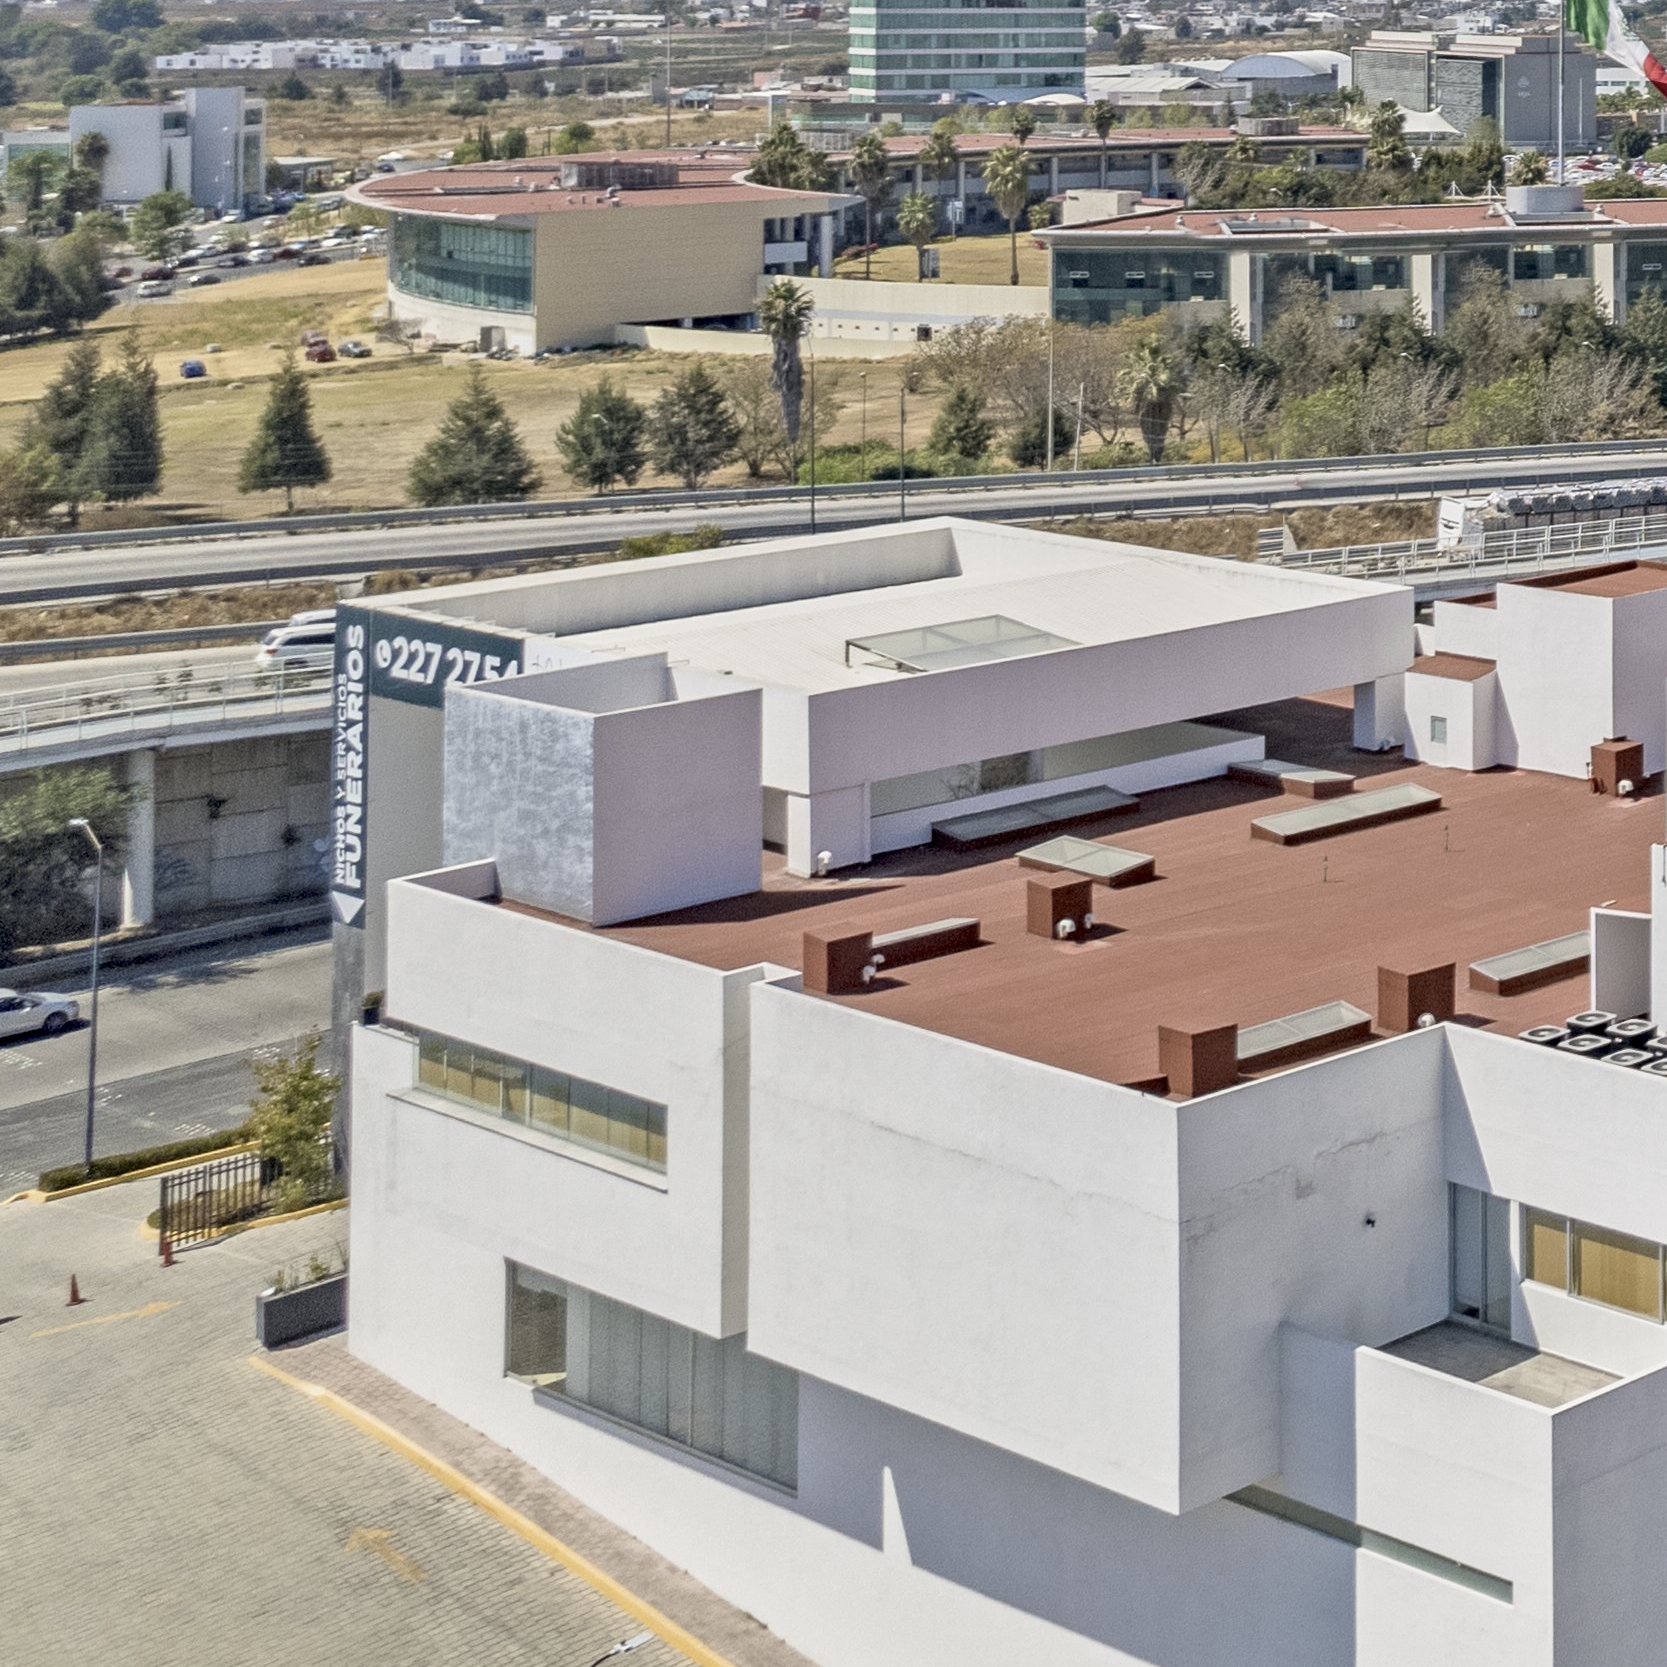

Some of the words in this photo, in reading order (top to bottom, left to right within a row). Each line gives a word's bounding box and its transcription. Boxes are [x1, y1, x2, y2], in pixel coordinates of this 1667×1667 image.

[390, 636, 443, 684] 227
[337, 673, 348, 781] SERVICIOS
[344, 624, 365, 889] FUNERARIOS
[334, 787, 346, 800] Y
[335, 806, 346, 885] NICHOS
